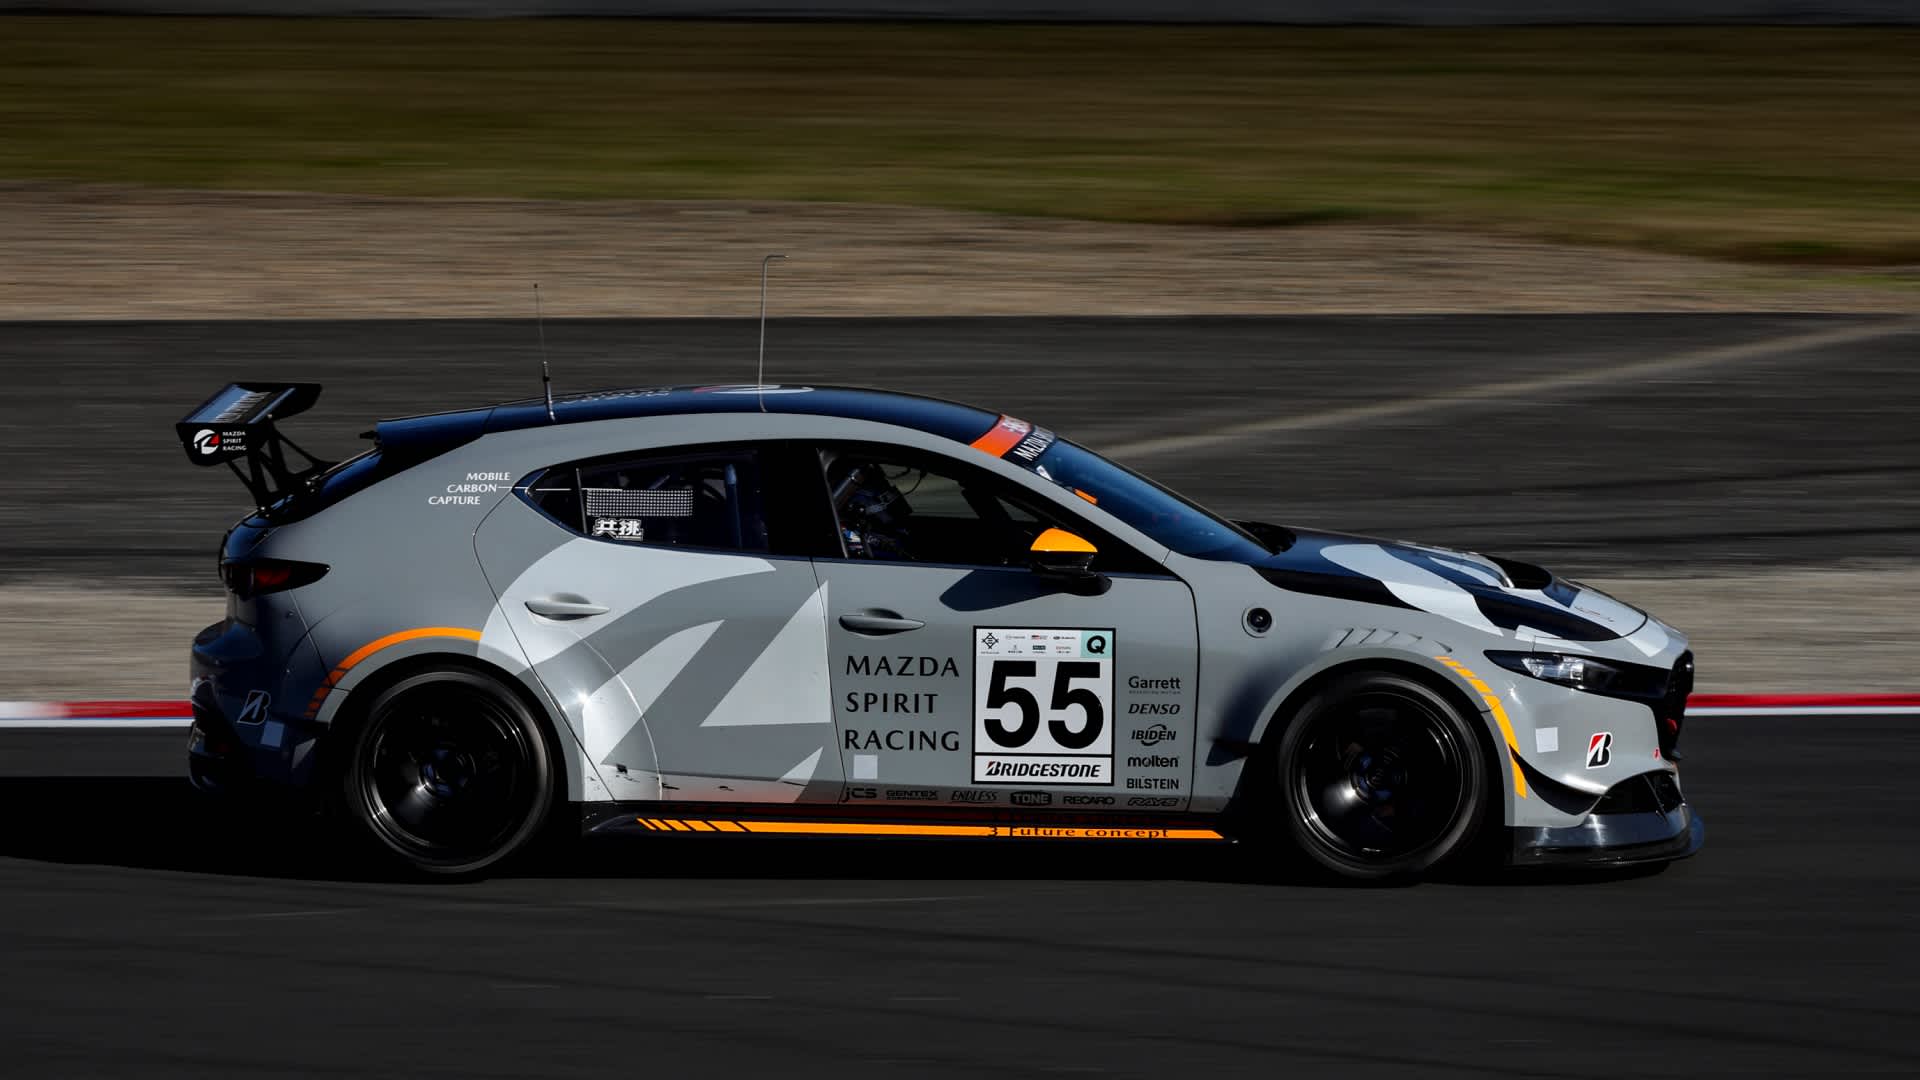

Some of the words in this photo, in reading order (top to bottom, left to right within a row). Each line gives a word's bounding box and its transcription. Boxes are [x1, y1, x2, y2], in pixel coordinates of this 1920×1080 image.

[466, 472, 511, 481] MOBILE
[447, 483, 498, 493] CARBON
[428, 495, 481, 505] CAPTURE
[594, 518, 643, 538] 共挑
[1086, 635, 1106, 655] Q
[846, 655, 959, 677] MAZDA
[1128, 676, 1181, 689] Garrett
[845, 691, 939, 713] SPIRIT
[984, 660, 1104, 749] 55
[1128, 703, 1180, 715] DENSO
[844, 729, 960, 751] RACING
[1131, 728, 1177, 741] IBIDEN
[1127, 755, 1179, 768] molten
[986, 760, 1102, 778] BRIDGESTONE
[1126, 777, 1180, 789] BILSTEIN
[886, 789, 938, 798] GENTEX
[950, 790, 999, 801] ENDLESS
[1012, 792, 1050, 804] TONE
[1063, 795, 1115, 805] RECARO
[1127, 796, 1180, 807] RAYS
[1009, 826, 1075, 838] Future
[1084, 828, 1169, 839] concept
